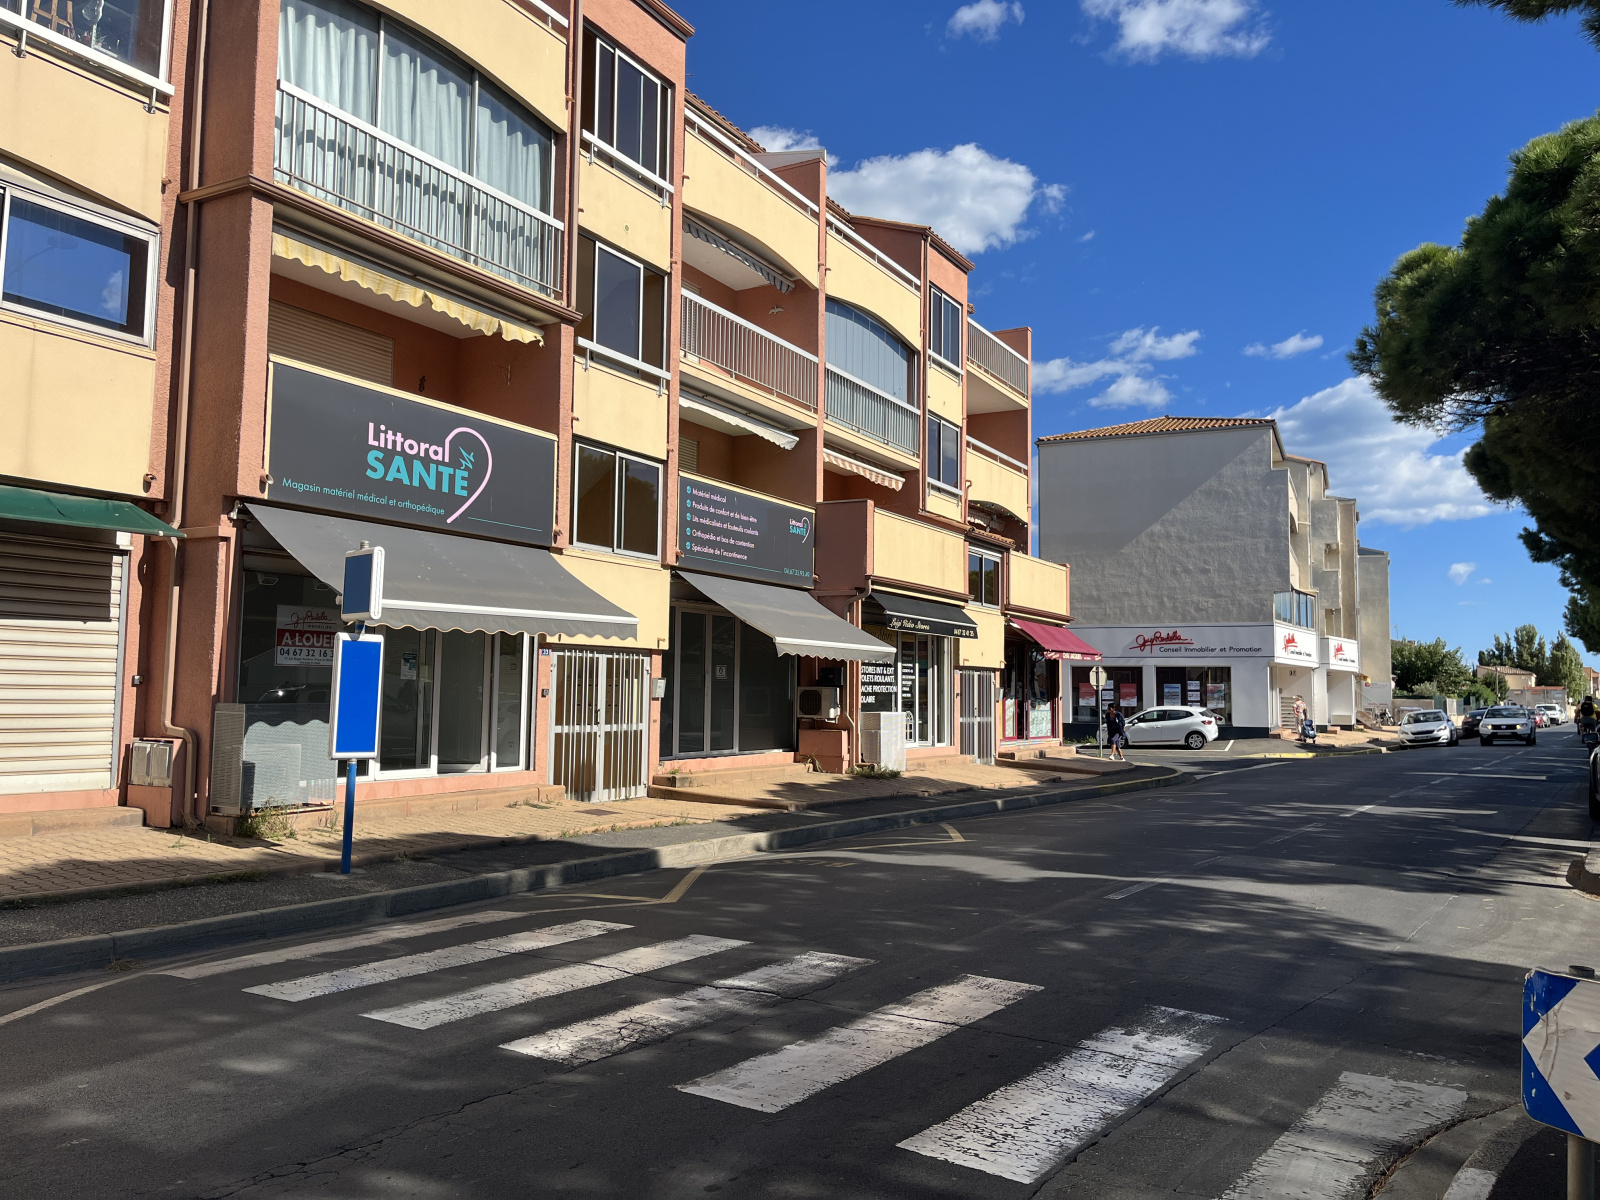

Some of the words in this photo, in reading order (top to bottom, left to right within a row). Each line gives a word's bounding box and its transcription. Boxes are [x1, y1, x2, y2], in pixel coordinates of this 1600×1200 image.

[367, 421, 450, 463] Littoral
[282, 477, 321, 494] Magasin
[323, 485, 355, 499] matériel
[357, 490, 387, 505] médical
[388, 497, 397, 506] et
[397, 499, 445, 516] orthopédique
[282, 632, 292, 646] A
[279, 648, 290, 656] 04
[292, 648, 303, 656] 67
[305, 649, 316, 657] 32
[319, 650, 328, 658] 16
[861, 674, 874, 682] OLETS
[872, 685, 898, 693] PROTECTION
[861, 695, 876, 703] OLAIRE
